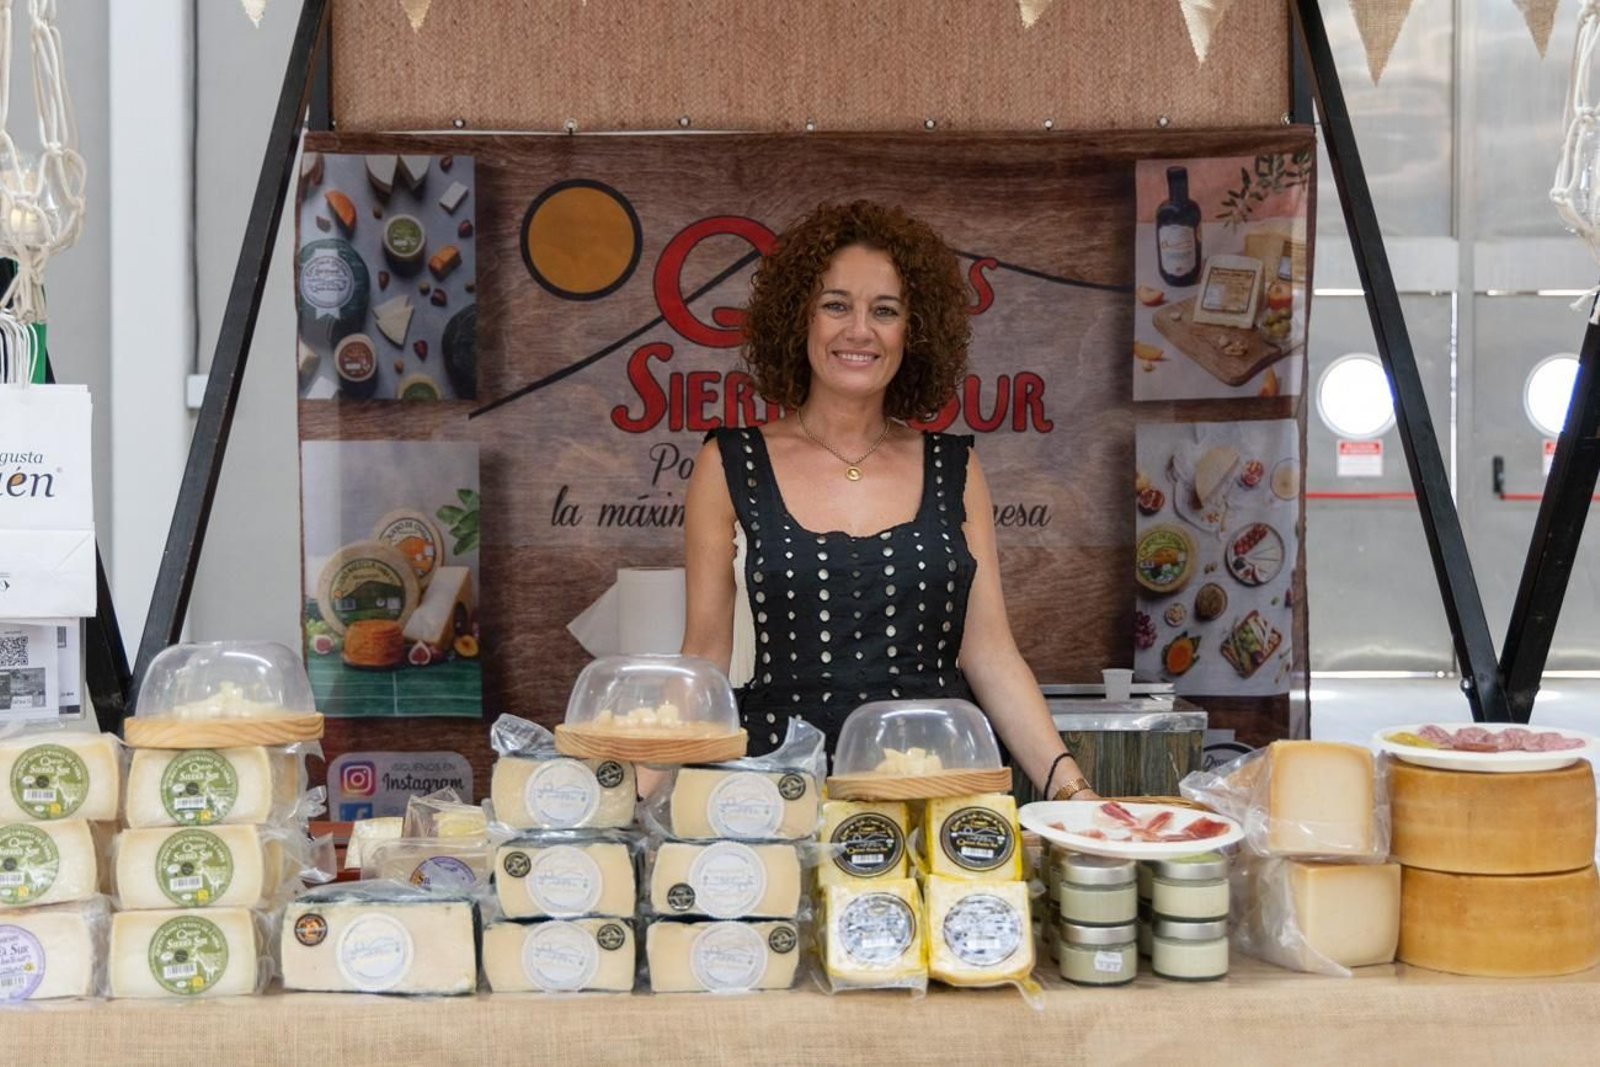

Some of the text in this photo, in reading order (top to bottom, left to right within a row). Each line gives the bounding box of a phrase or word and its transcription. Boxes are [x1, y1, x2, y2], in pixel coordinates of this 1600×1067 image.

[610, 342, 797, 434] SIER
[649, 442, 696, 486] Po
[551, 485, 583, 528] la
[382, 772, 465, 796] Instagram
